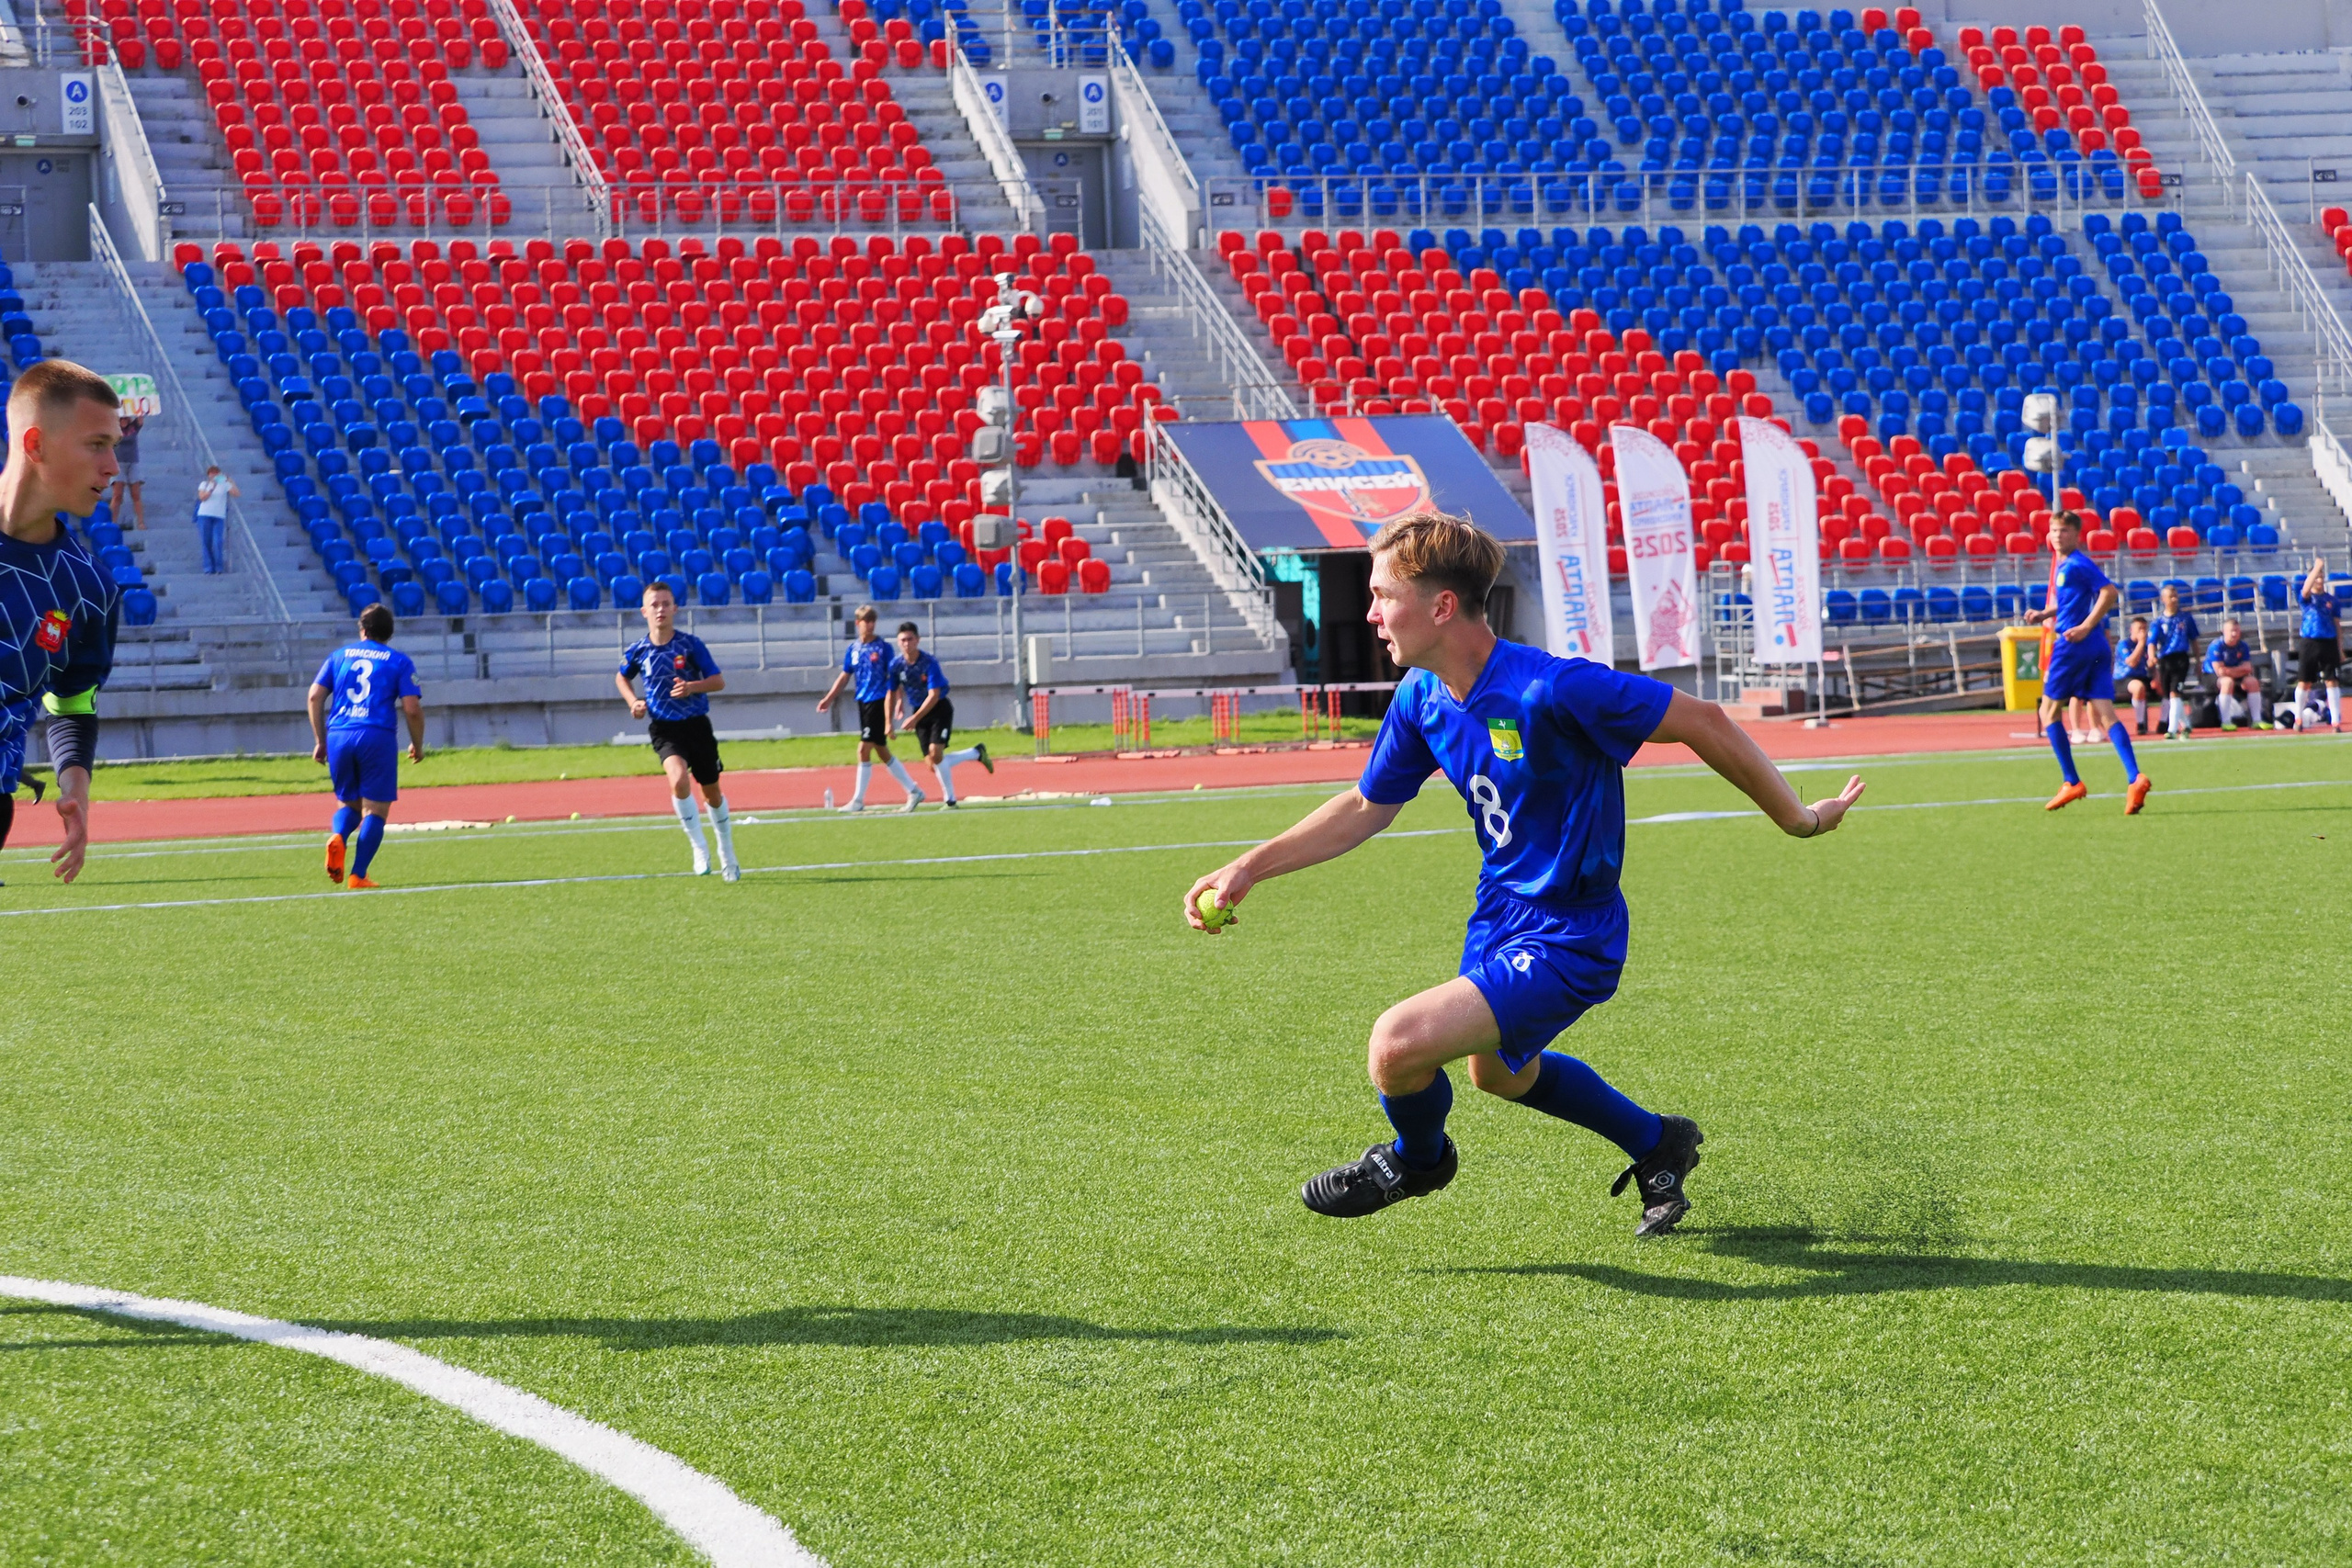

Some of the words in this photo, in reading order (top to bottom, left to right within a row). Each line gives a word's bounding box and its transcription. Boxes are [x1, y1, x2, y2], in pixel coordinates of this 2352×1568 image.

[1275, 471, 1424, 492] ЕНИСЕЙ
[345, 649, 391, 661] ТОМСКИЙ
[346, 659, 374, 705] 3
[863, 727, 871, 739] 2
[1469, 773, 1513, 849] 8
